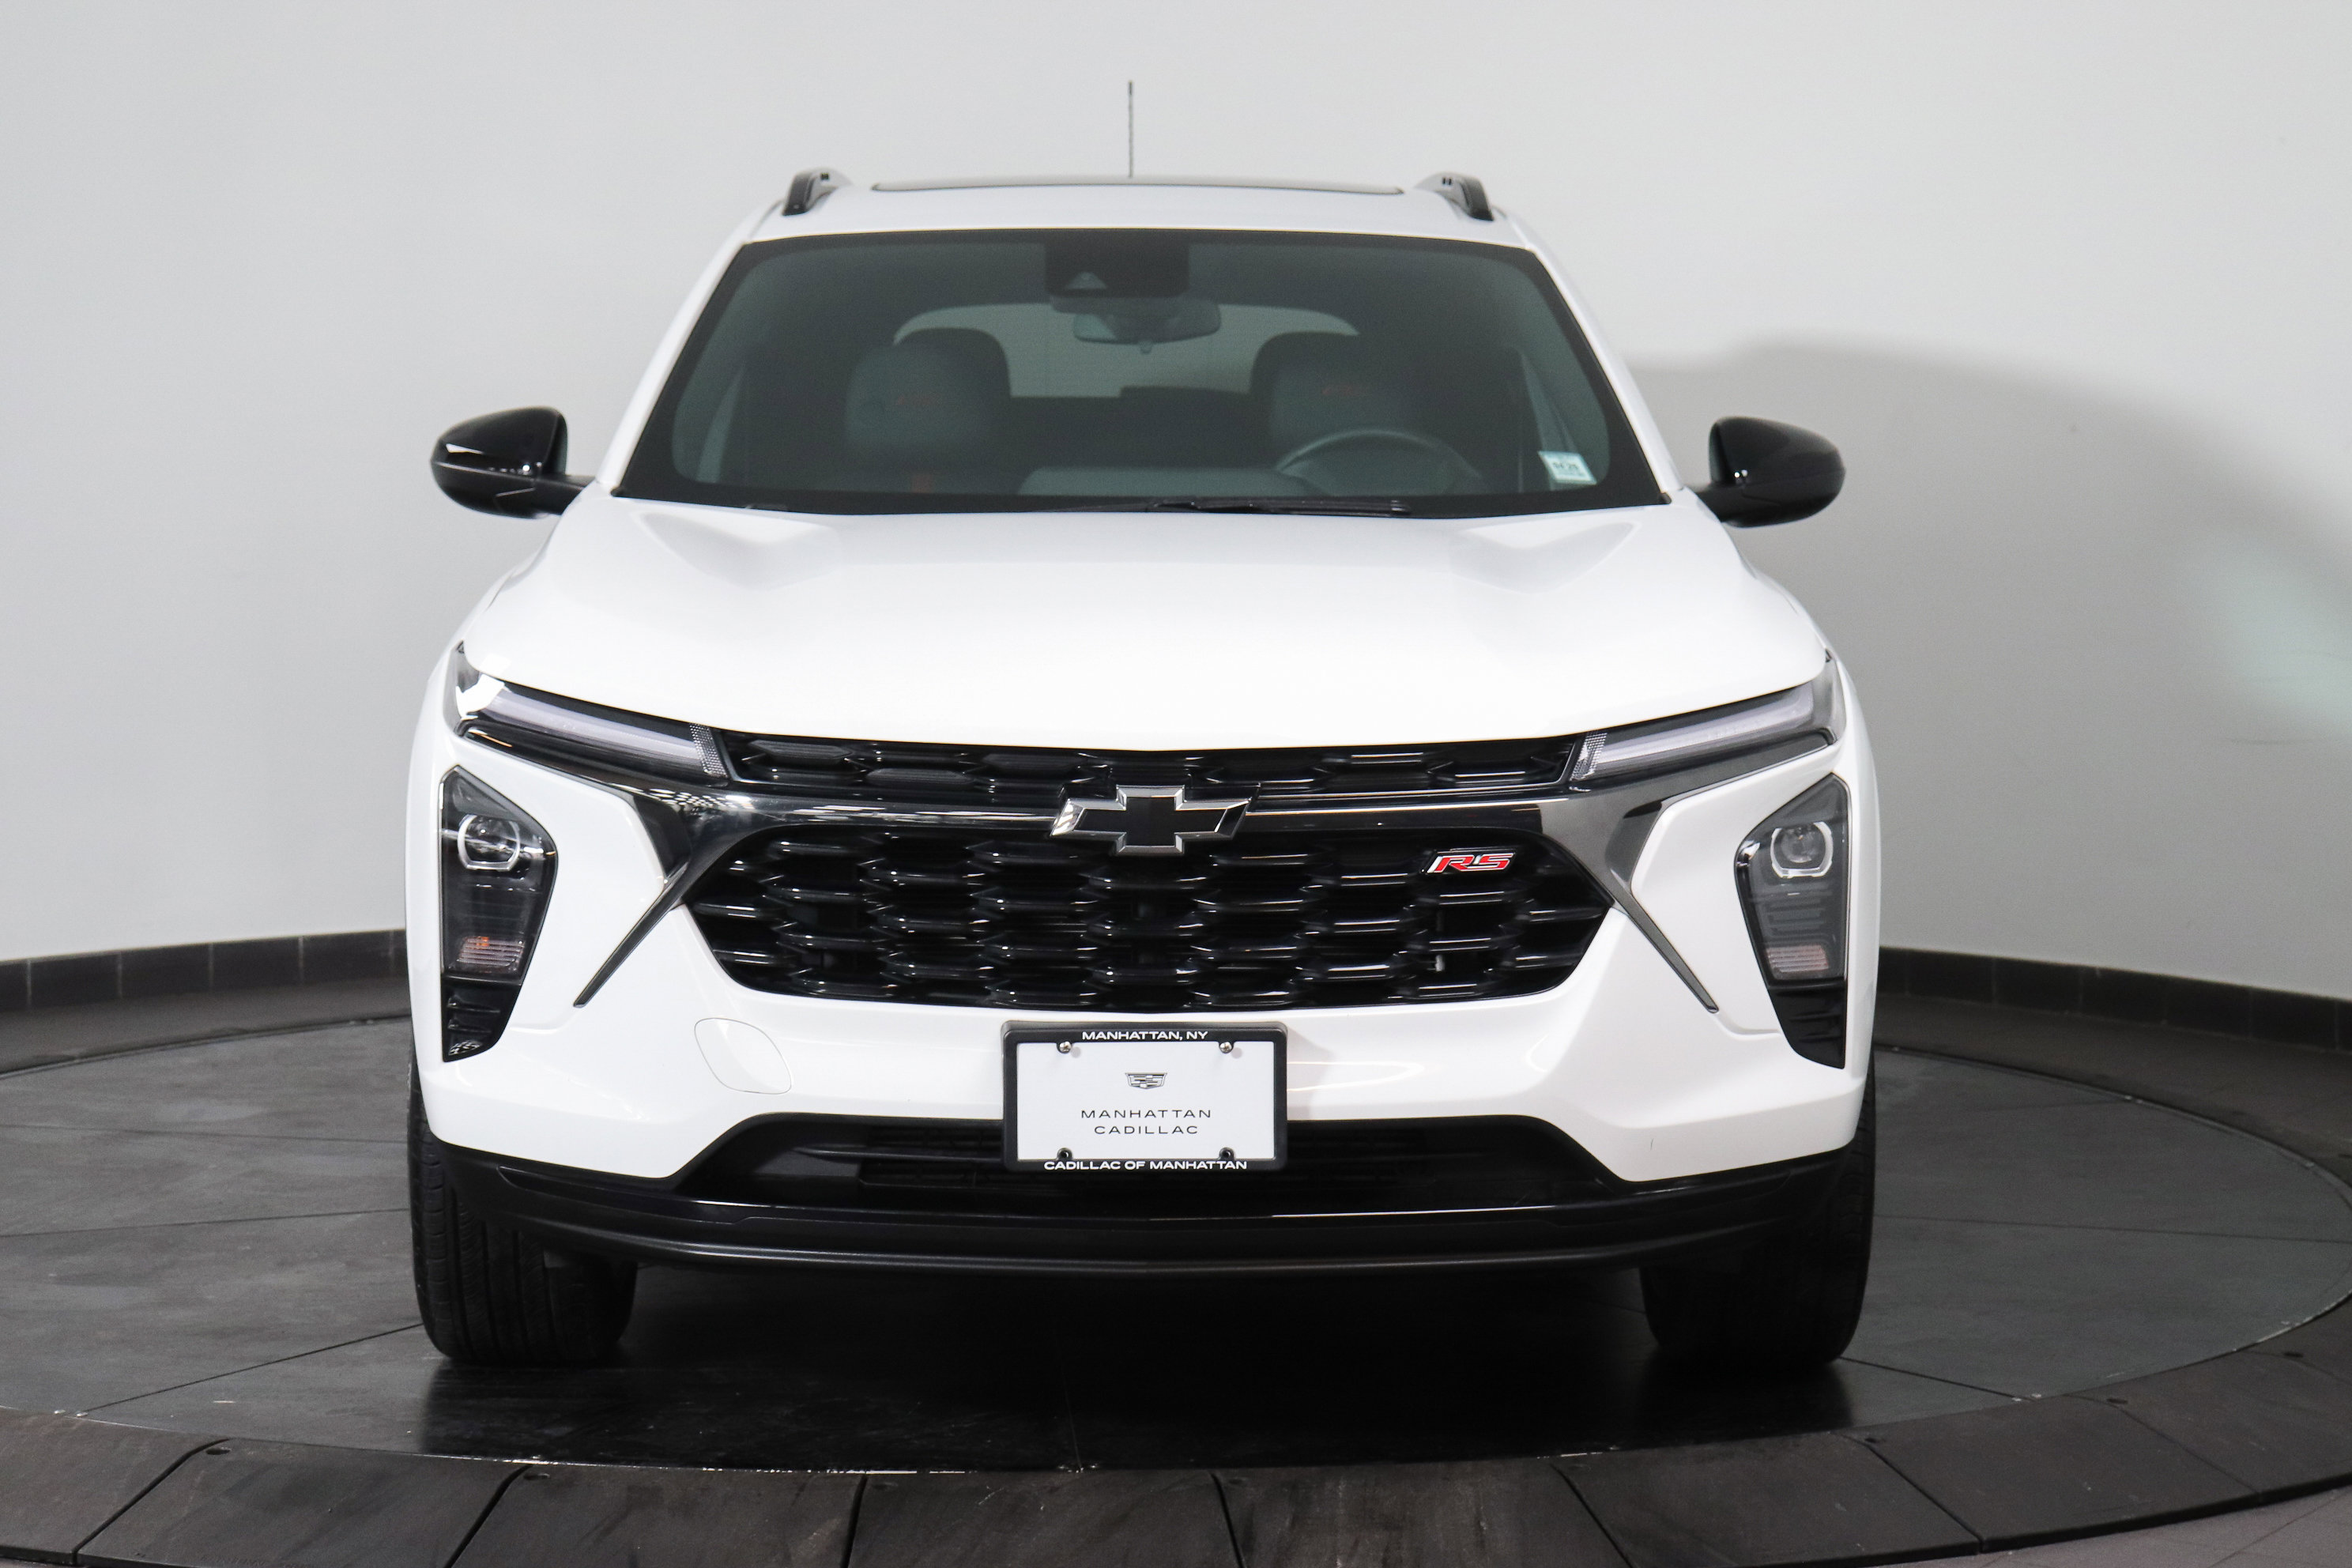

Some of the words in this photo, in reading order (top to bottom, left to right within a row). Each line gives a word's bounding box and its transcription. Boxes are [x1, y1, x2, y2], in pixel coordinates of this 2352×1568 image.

[1427, 853, 1515, 873] RS
[1082, 1031, 1183, 1041] MANHATTAN,
[1186, 1031, 1208, 1040] NY
[1081, 1110, 1211, 1118] MANHATTAN
[1094, 1125, 1198, 1135] CADILLAC
[1043, 1161, 1121, 1170] CADILLAC
[1124, 1161, 1146, 1170] OF
[1149, 1160, 1247, 1170] MANHATTAN
